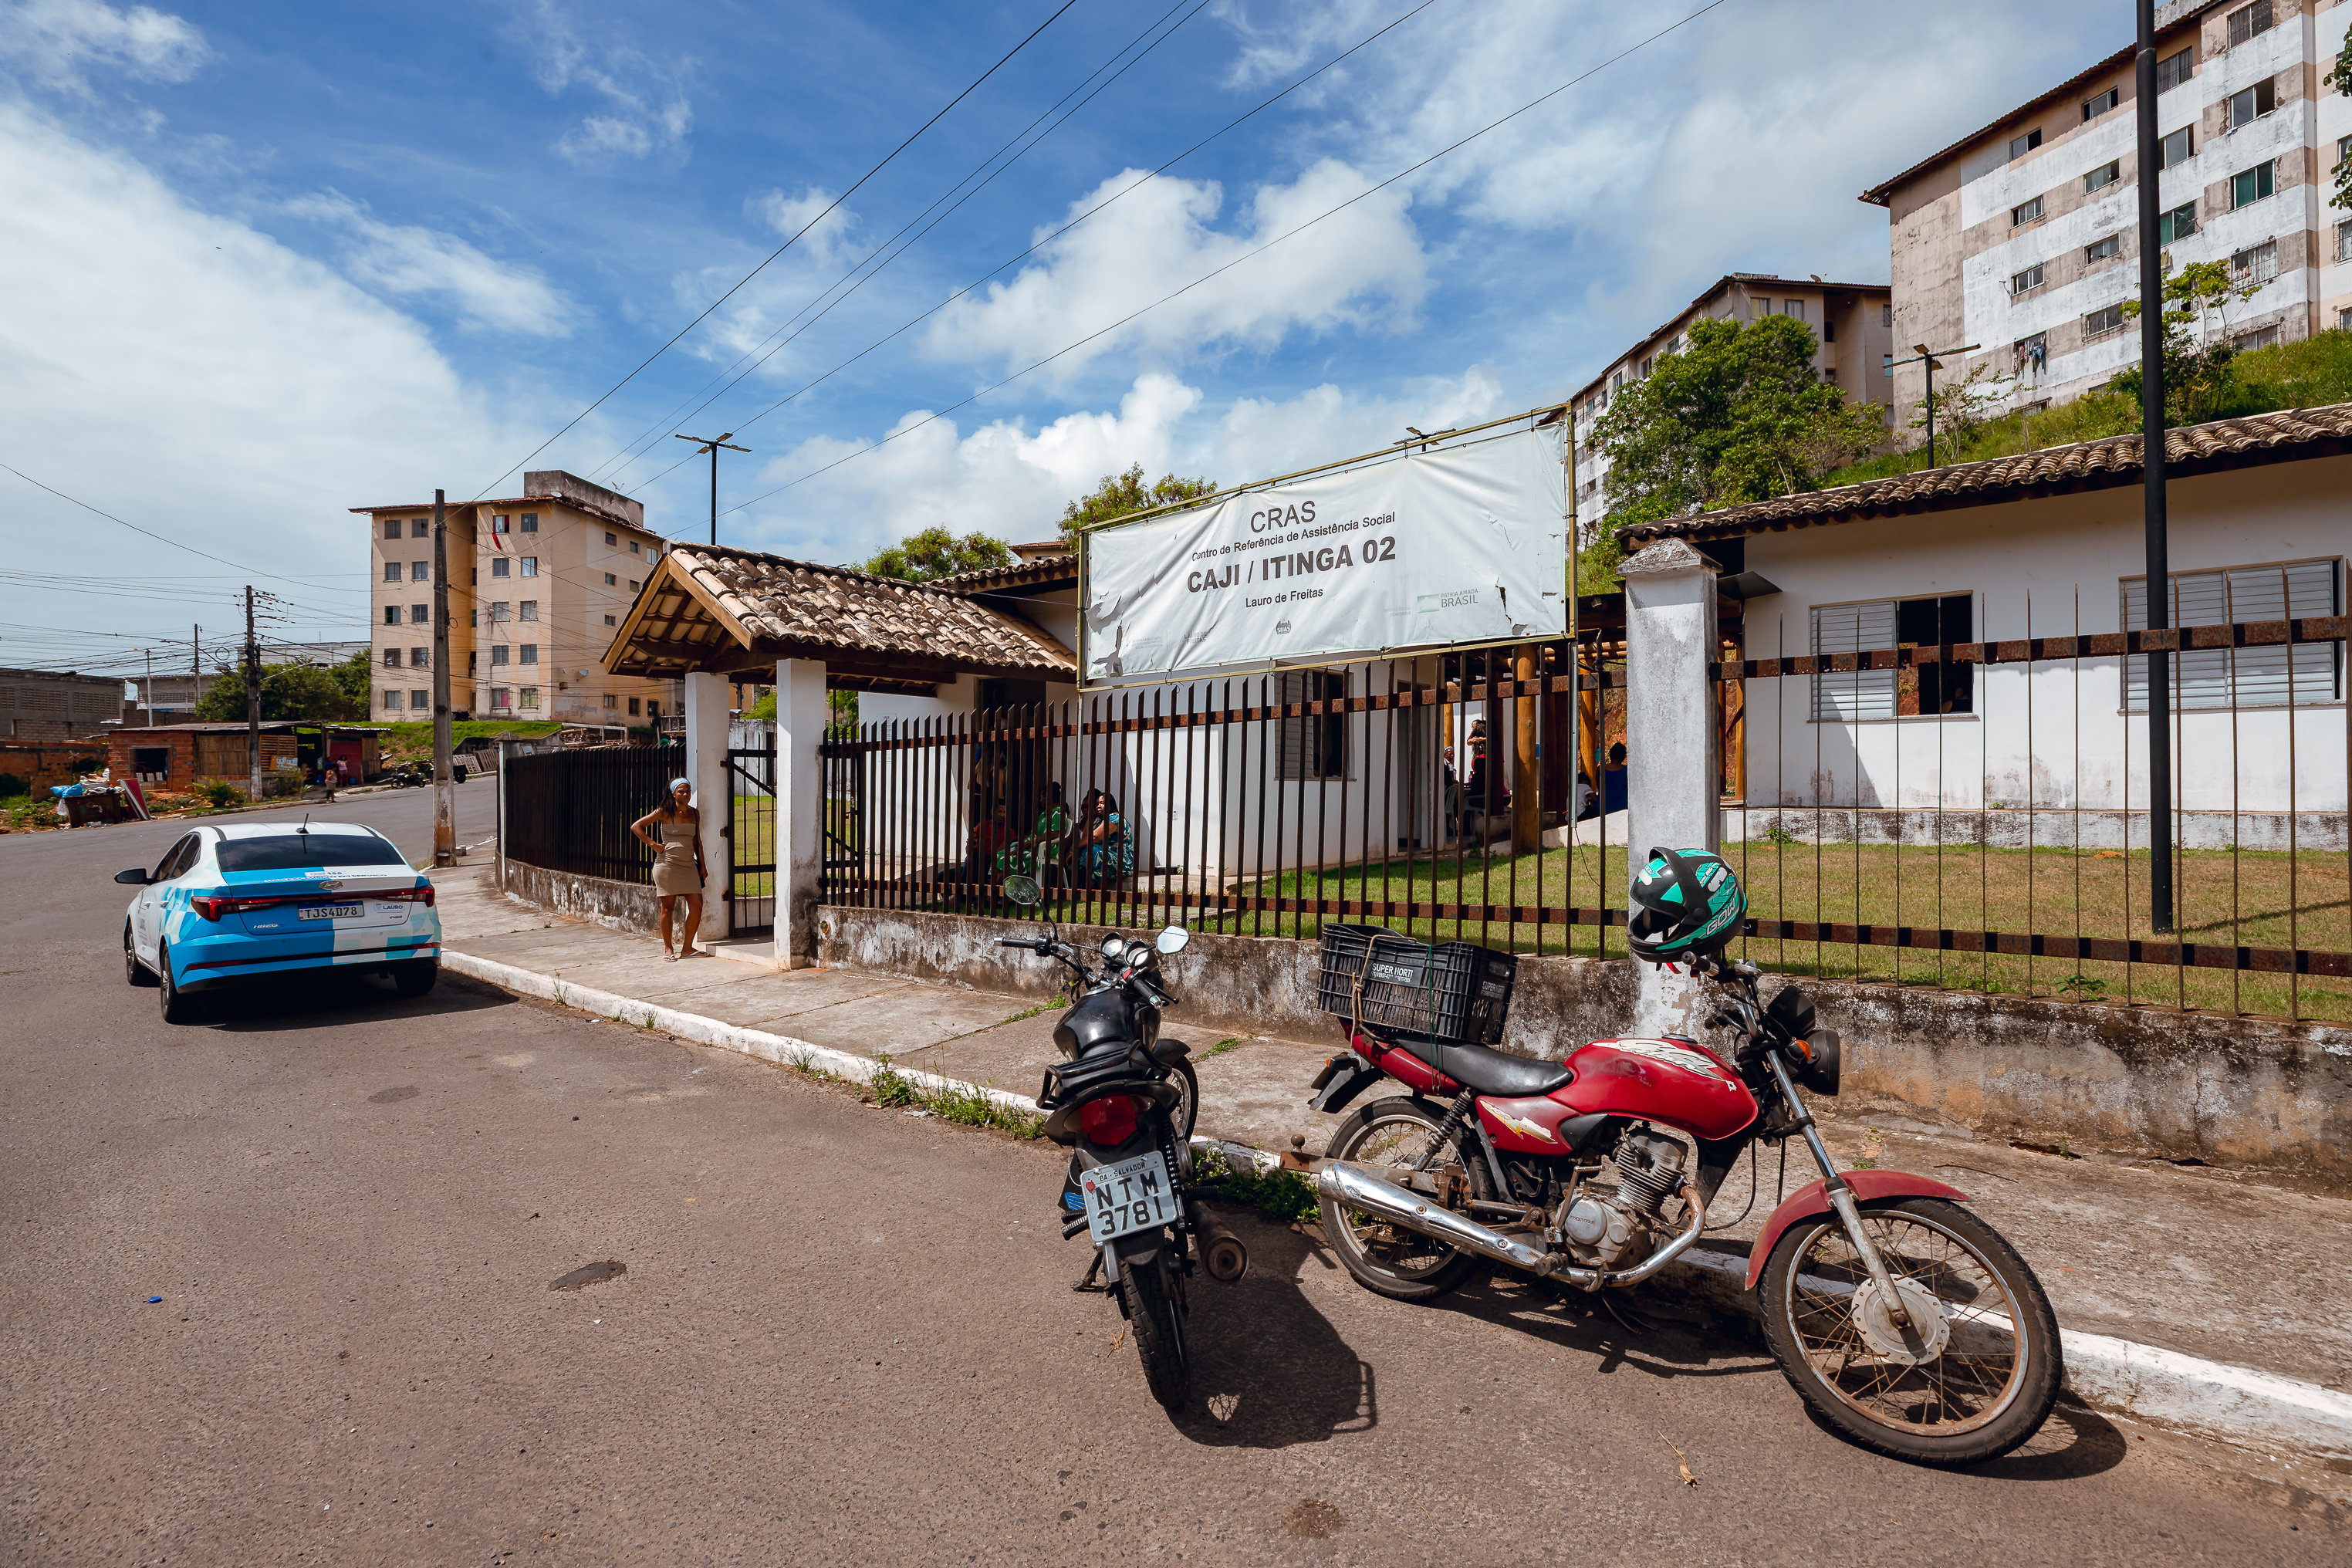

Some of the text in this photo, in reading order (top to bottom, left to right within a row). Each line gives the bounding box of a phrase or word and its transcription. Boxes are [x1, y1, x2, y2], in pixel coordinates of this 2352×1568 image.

[1250, 501, 1316, 533] CRAS
[1191, 512, 1395, 562] Centro de Referência de Assistência Social
[1187, 536, 1397, 593] CAJI / ITINGA 02
[1245, 588, 1323, 608] Lauro de Freitas
[1441, 594, 1479, 608] BRASIL
[304, 906, 357, 918] TJS4D78
[1372, 962, 1394, 975] SUPER
[1394, 967, 1414, 978] HORTI
[1099, 1174, 1108, 1182] BA
[1113, 1162, 1146, 1178] SALVADOR
[1094, 1170, 1160, 1211] NTM
[1097, 1196, 1164, 1236] 3781
[1570, 1215, 1597, 1225] HONDA
